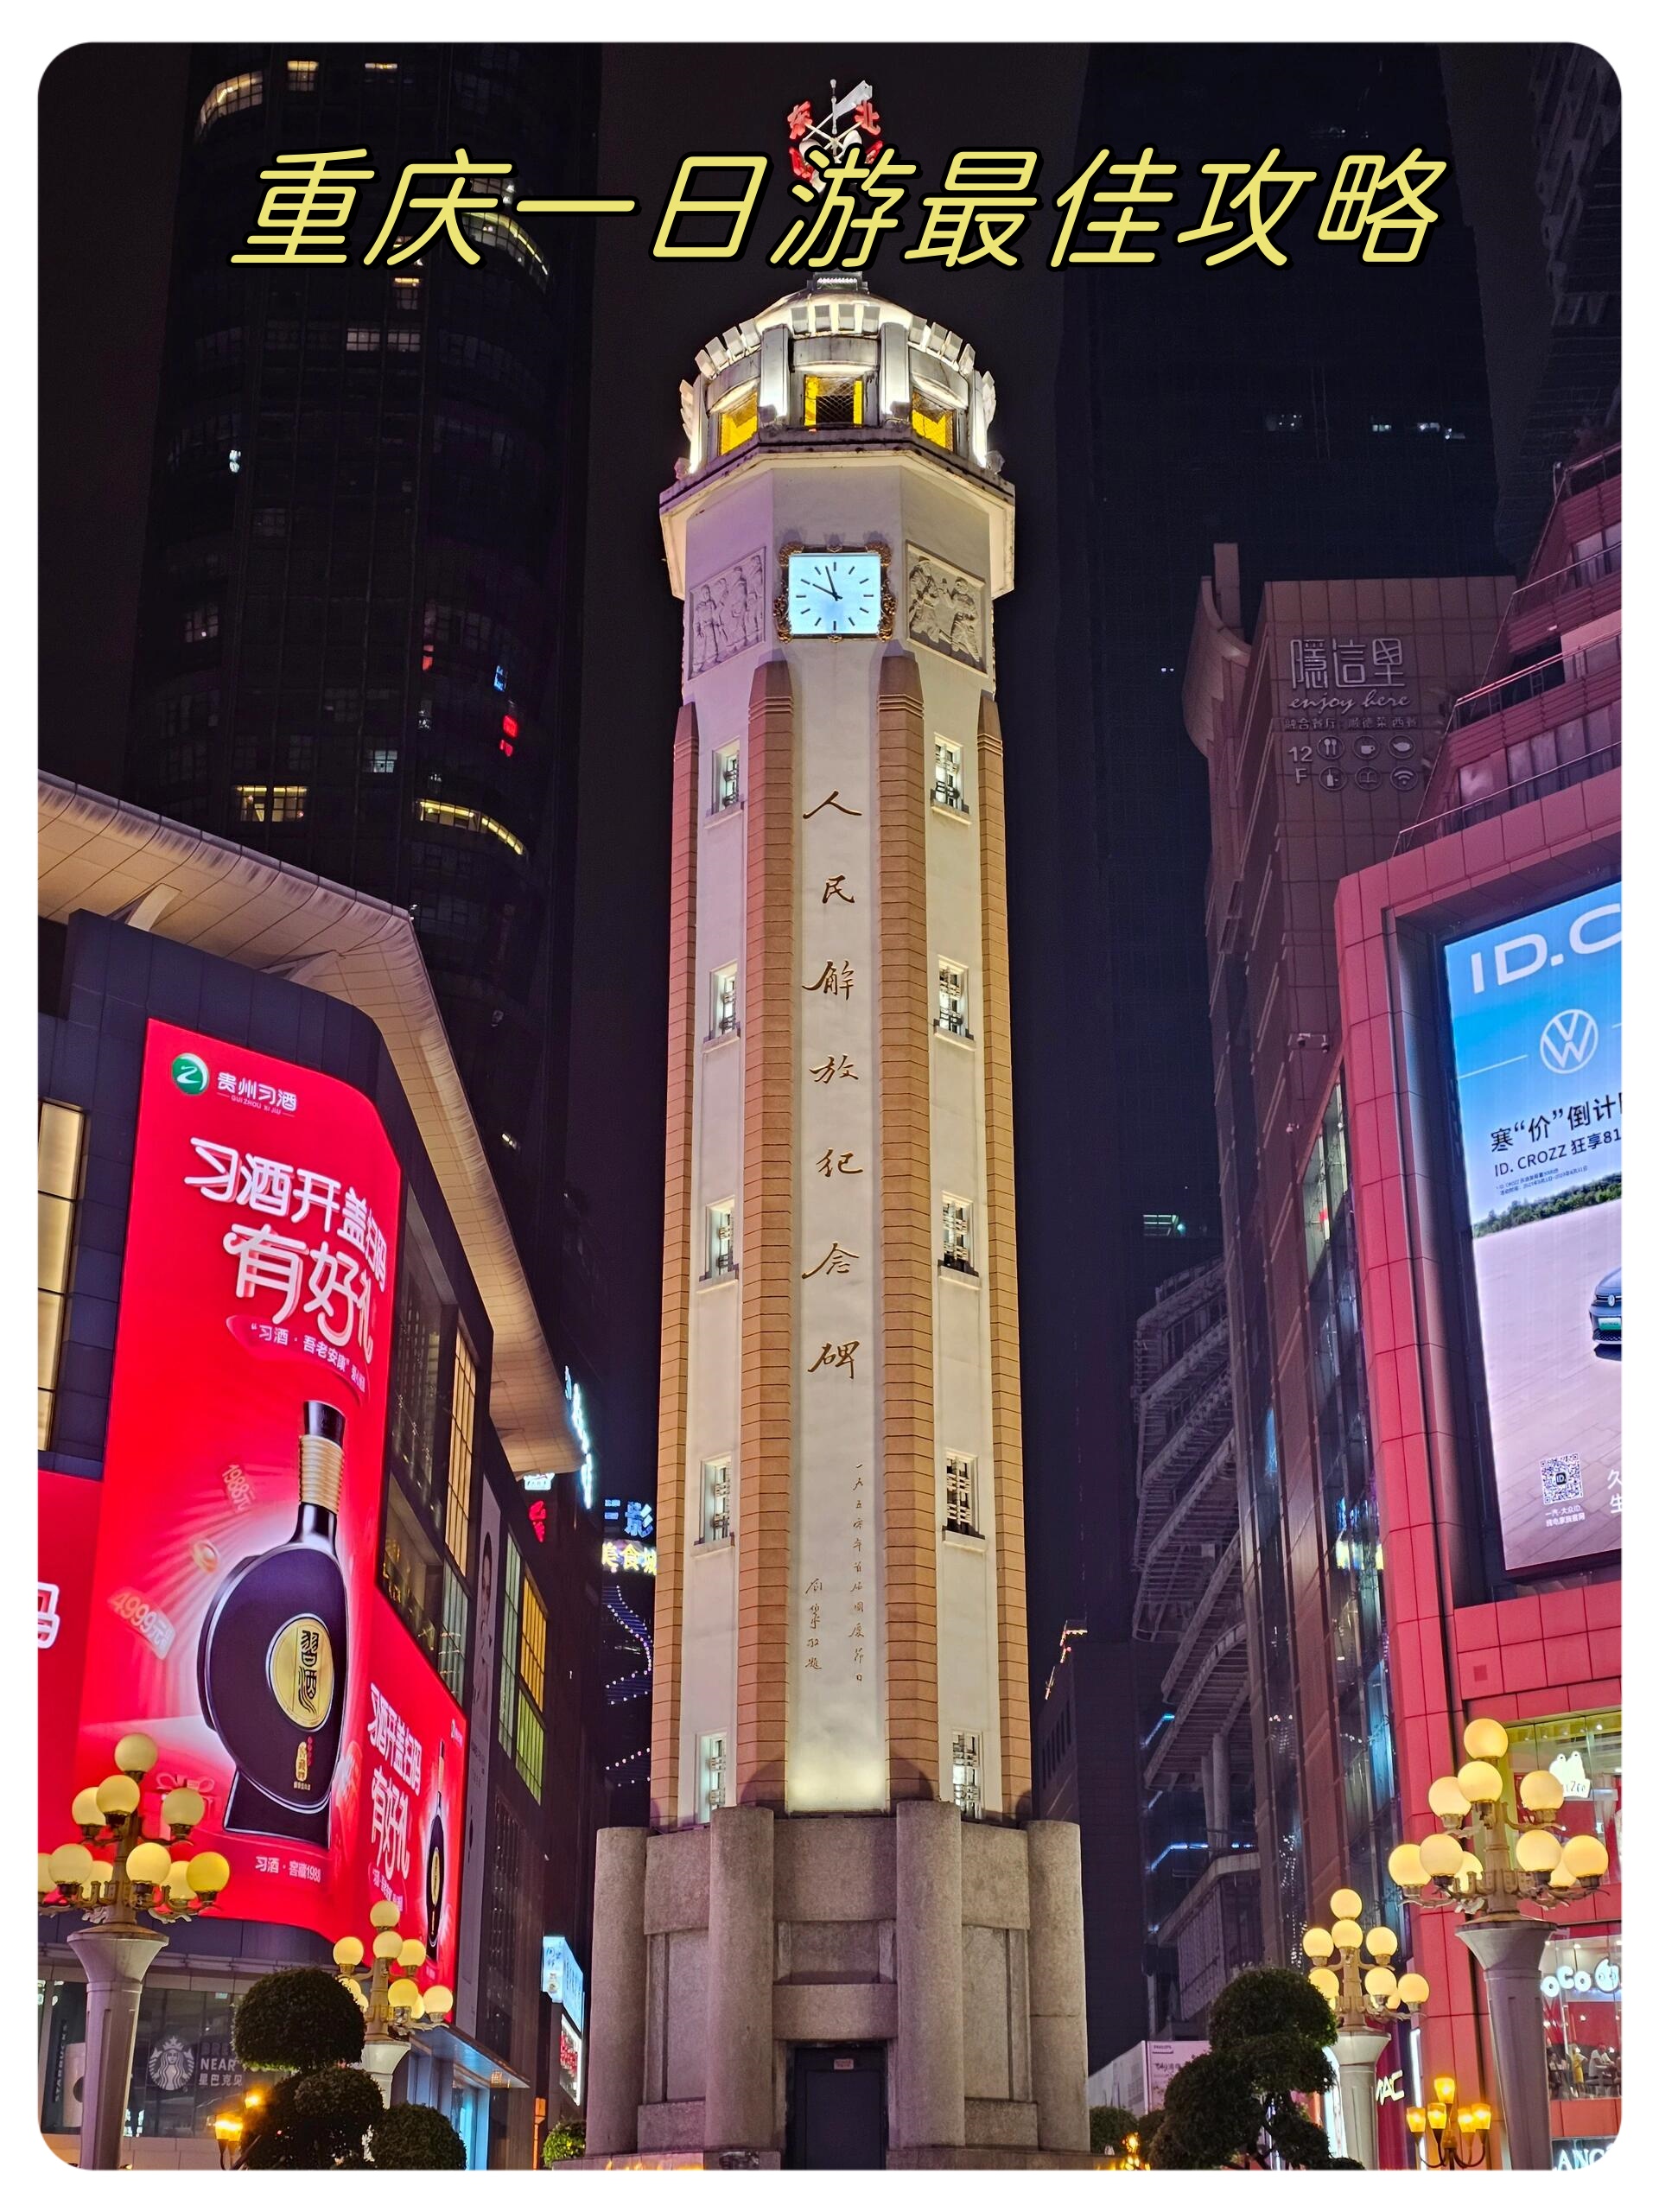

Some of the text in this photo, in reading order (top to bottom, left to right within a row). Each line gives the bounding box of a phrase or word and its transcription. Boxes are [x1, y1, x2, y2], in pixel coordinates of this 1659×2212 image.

[1287, 689, 1411, 715] enjoy here
[1288, 746, 1313, 762] 12
[1295, 767, 1307, 784] F
[217, 1072, 297, 1112] 贵州习酒
[1491, 1093, 1622, 1153] 寒“价”倒计
[1517, 1144, 1567, 1170] CROZZ
[184, 1136, 387, 1293] 习酒开盖扫码
[222, 1223, 373, 1365] 有好礼
[200, 2057, 236, 2072] NEAR
